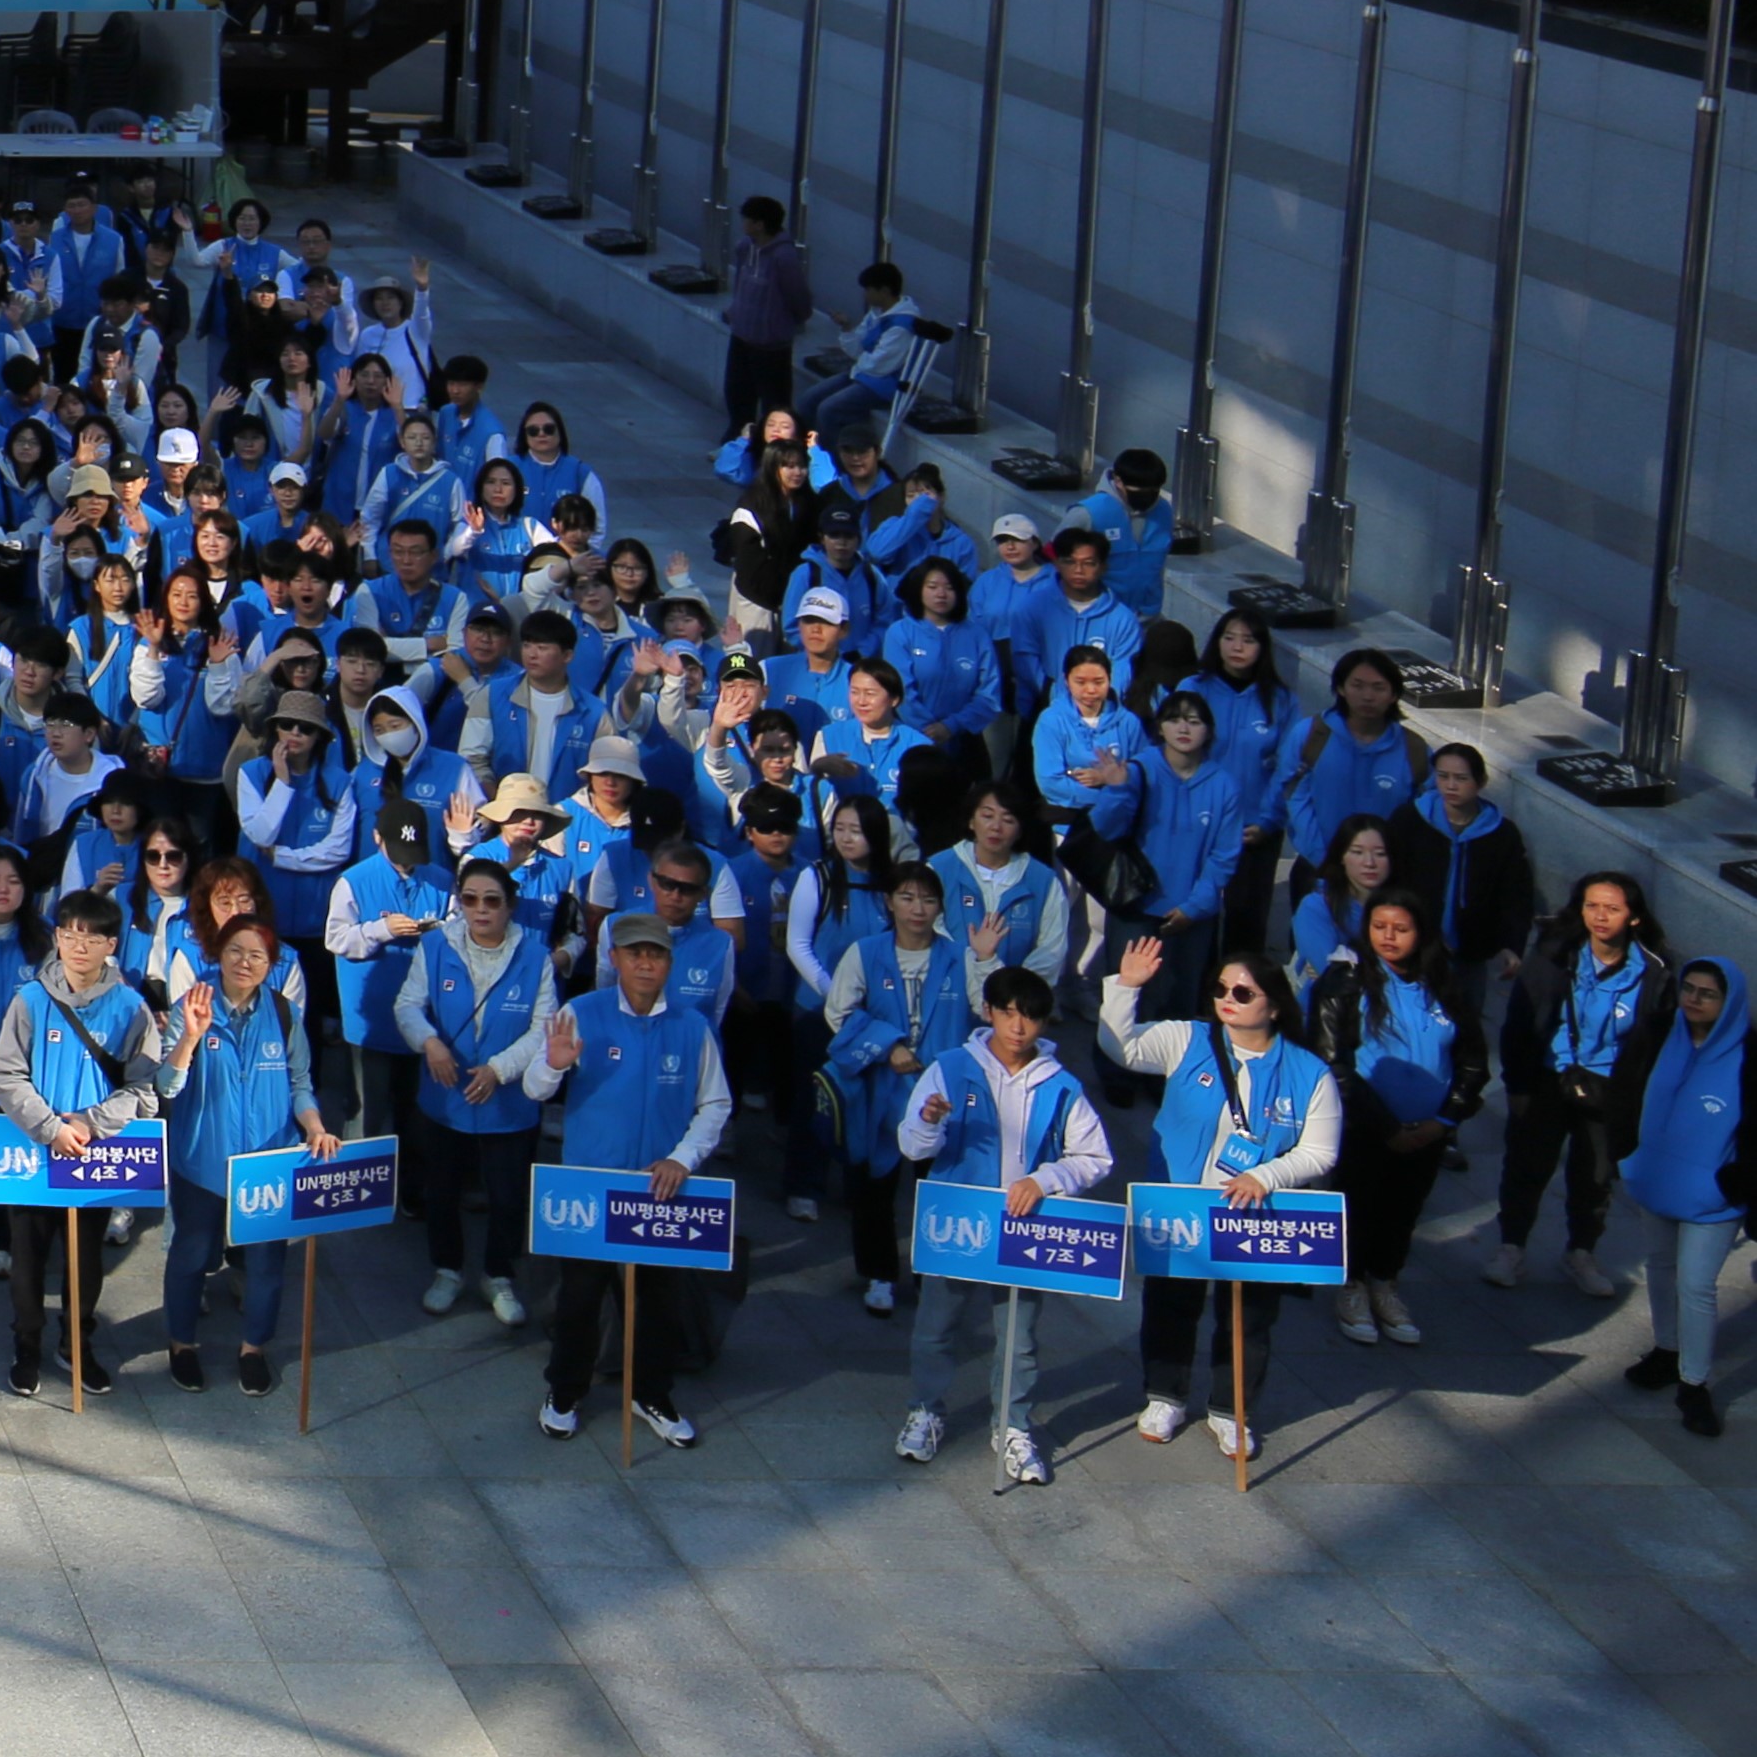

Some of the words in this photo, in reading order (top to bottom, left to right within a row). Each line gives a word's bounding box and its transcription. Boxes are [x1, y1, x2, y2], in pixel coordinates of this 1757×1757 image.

[401, 825, 417, 841] NY
[1227, 1143, 1255, 1165] UN
[90, 1166, 119, 1182] 4조
[296, 1165, 391, 1193] UN평화봉사단
[240, 1184, 284, 1214] UN
[331, 1189, 356, 1208] 5조
[544, 1197, 597, 1228] UN
[610, 1200, 726, 1225] UN평화봉사단
[651, 1222, 682, 1239] 6조
[928, 1213, 985, 1247] UN
[1003, 1219, 1118, 1250] UN평화봉사단
[1143, 1217, 1200, 1247] UN
[1213, 1216, 1337, 1240] UN평화봉사단
[1045, 1247, 1076, 1265] 7조
[1259, 1239, 1292, 1256] 8조
